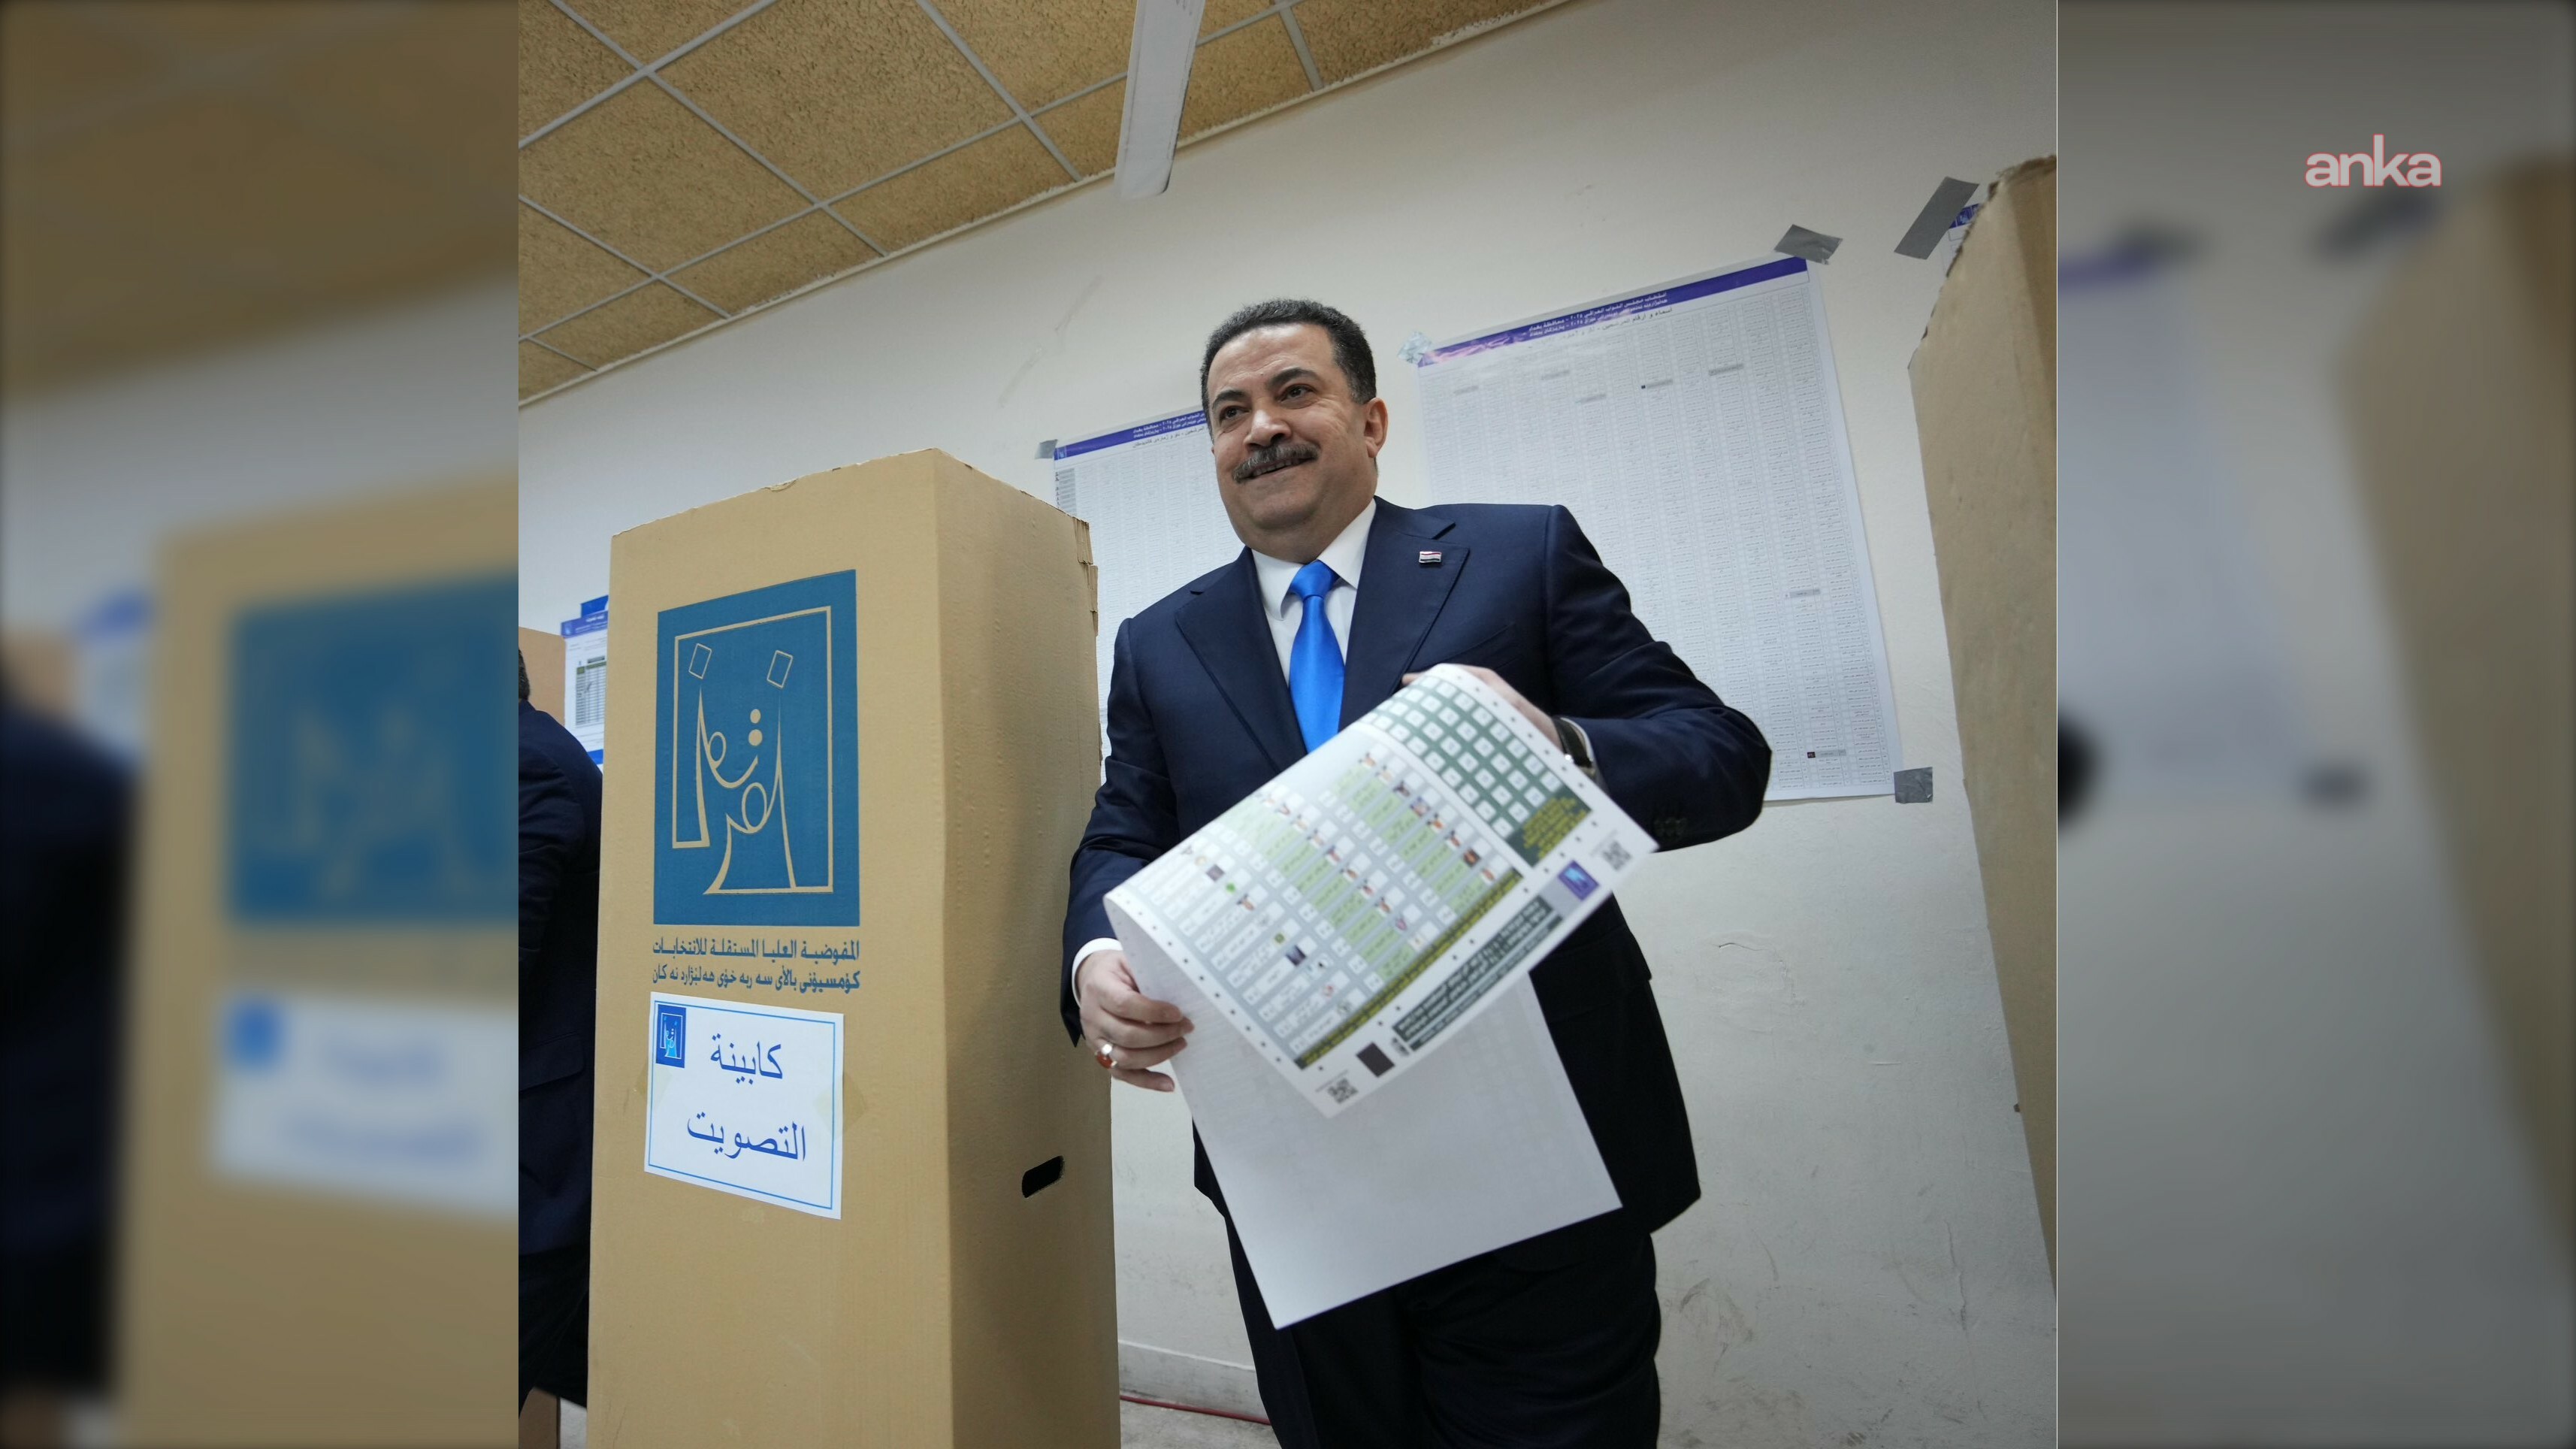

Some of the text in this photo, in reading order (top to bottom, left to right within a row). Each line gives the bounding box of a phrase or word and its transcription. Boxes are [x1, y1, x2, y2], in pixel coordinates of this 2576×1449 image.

[653, 936, 860, 965] المفوضية العليا المستقلة للانتخابات
[710, 1033, 783, 1084] كابينة
[687, 1112, 806, 1162] التصويت
